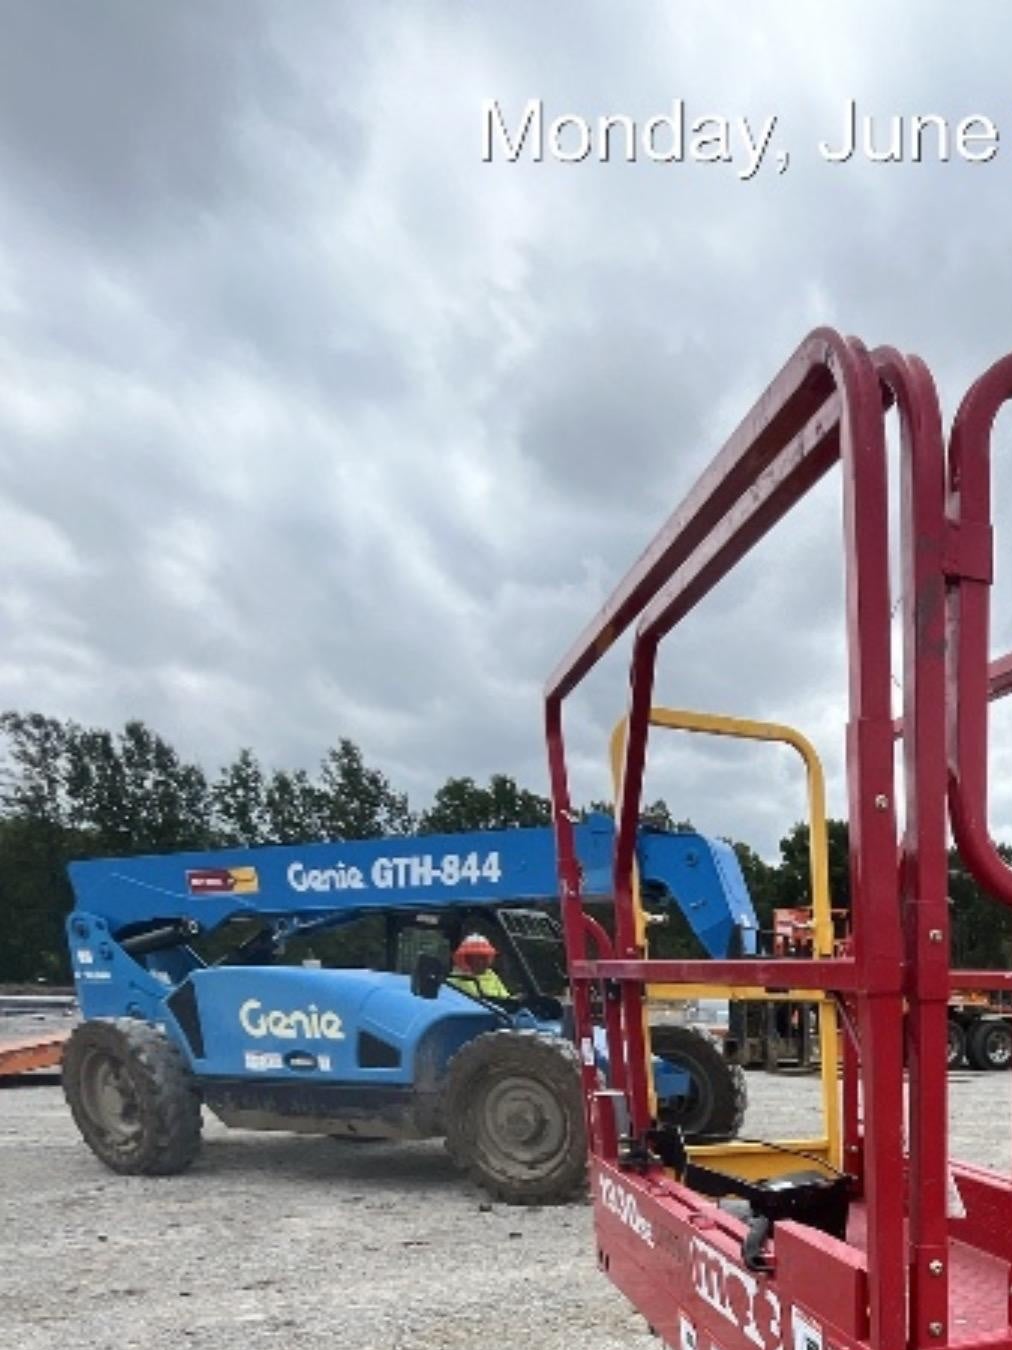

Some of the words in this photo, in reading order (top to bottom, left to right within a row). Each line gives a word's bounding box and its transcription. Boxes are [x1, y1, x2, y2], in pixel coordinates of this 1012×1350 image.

[287, 861, 367, 892] Genie
[371, 851, 501, 889] GTH-844
[239, 999, 346, 1039] Genie
